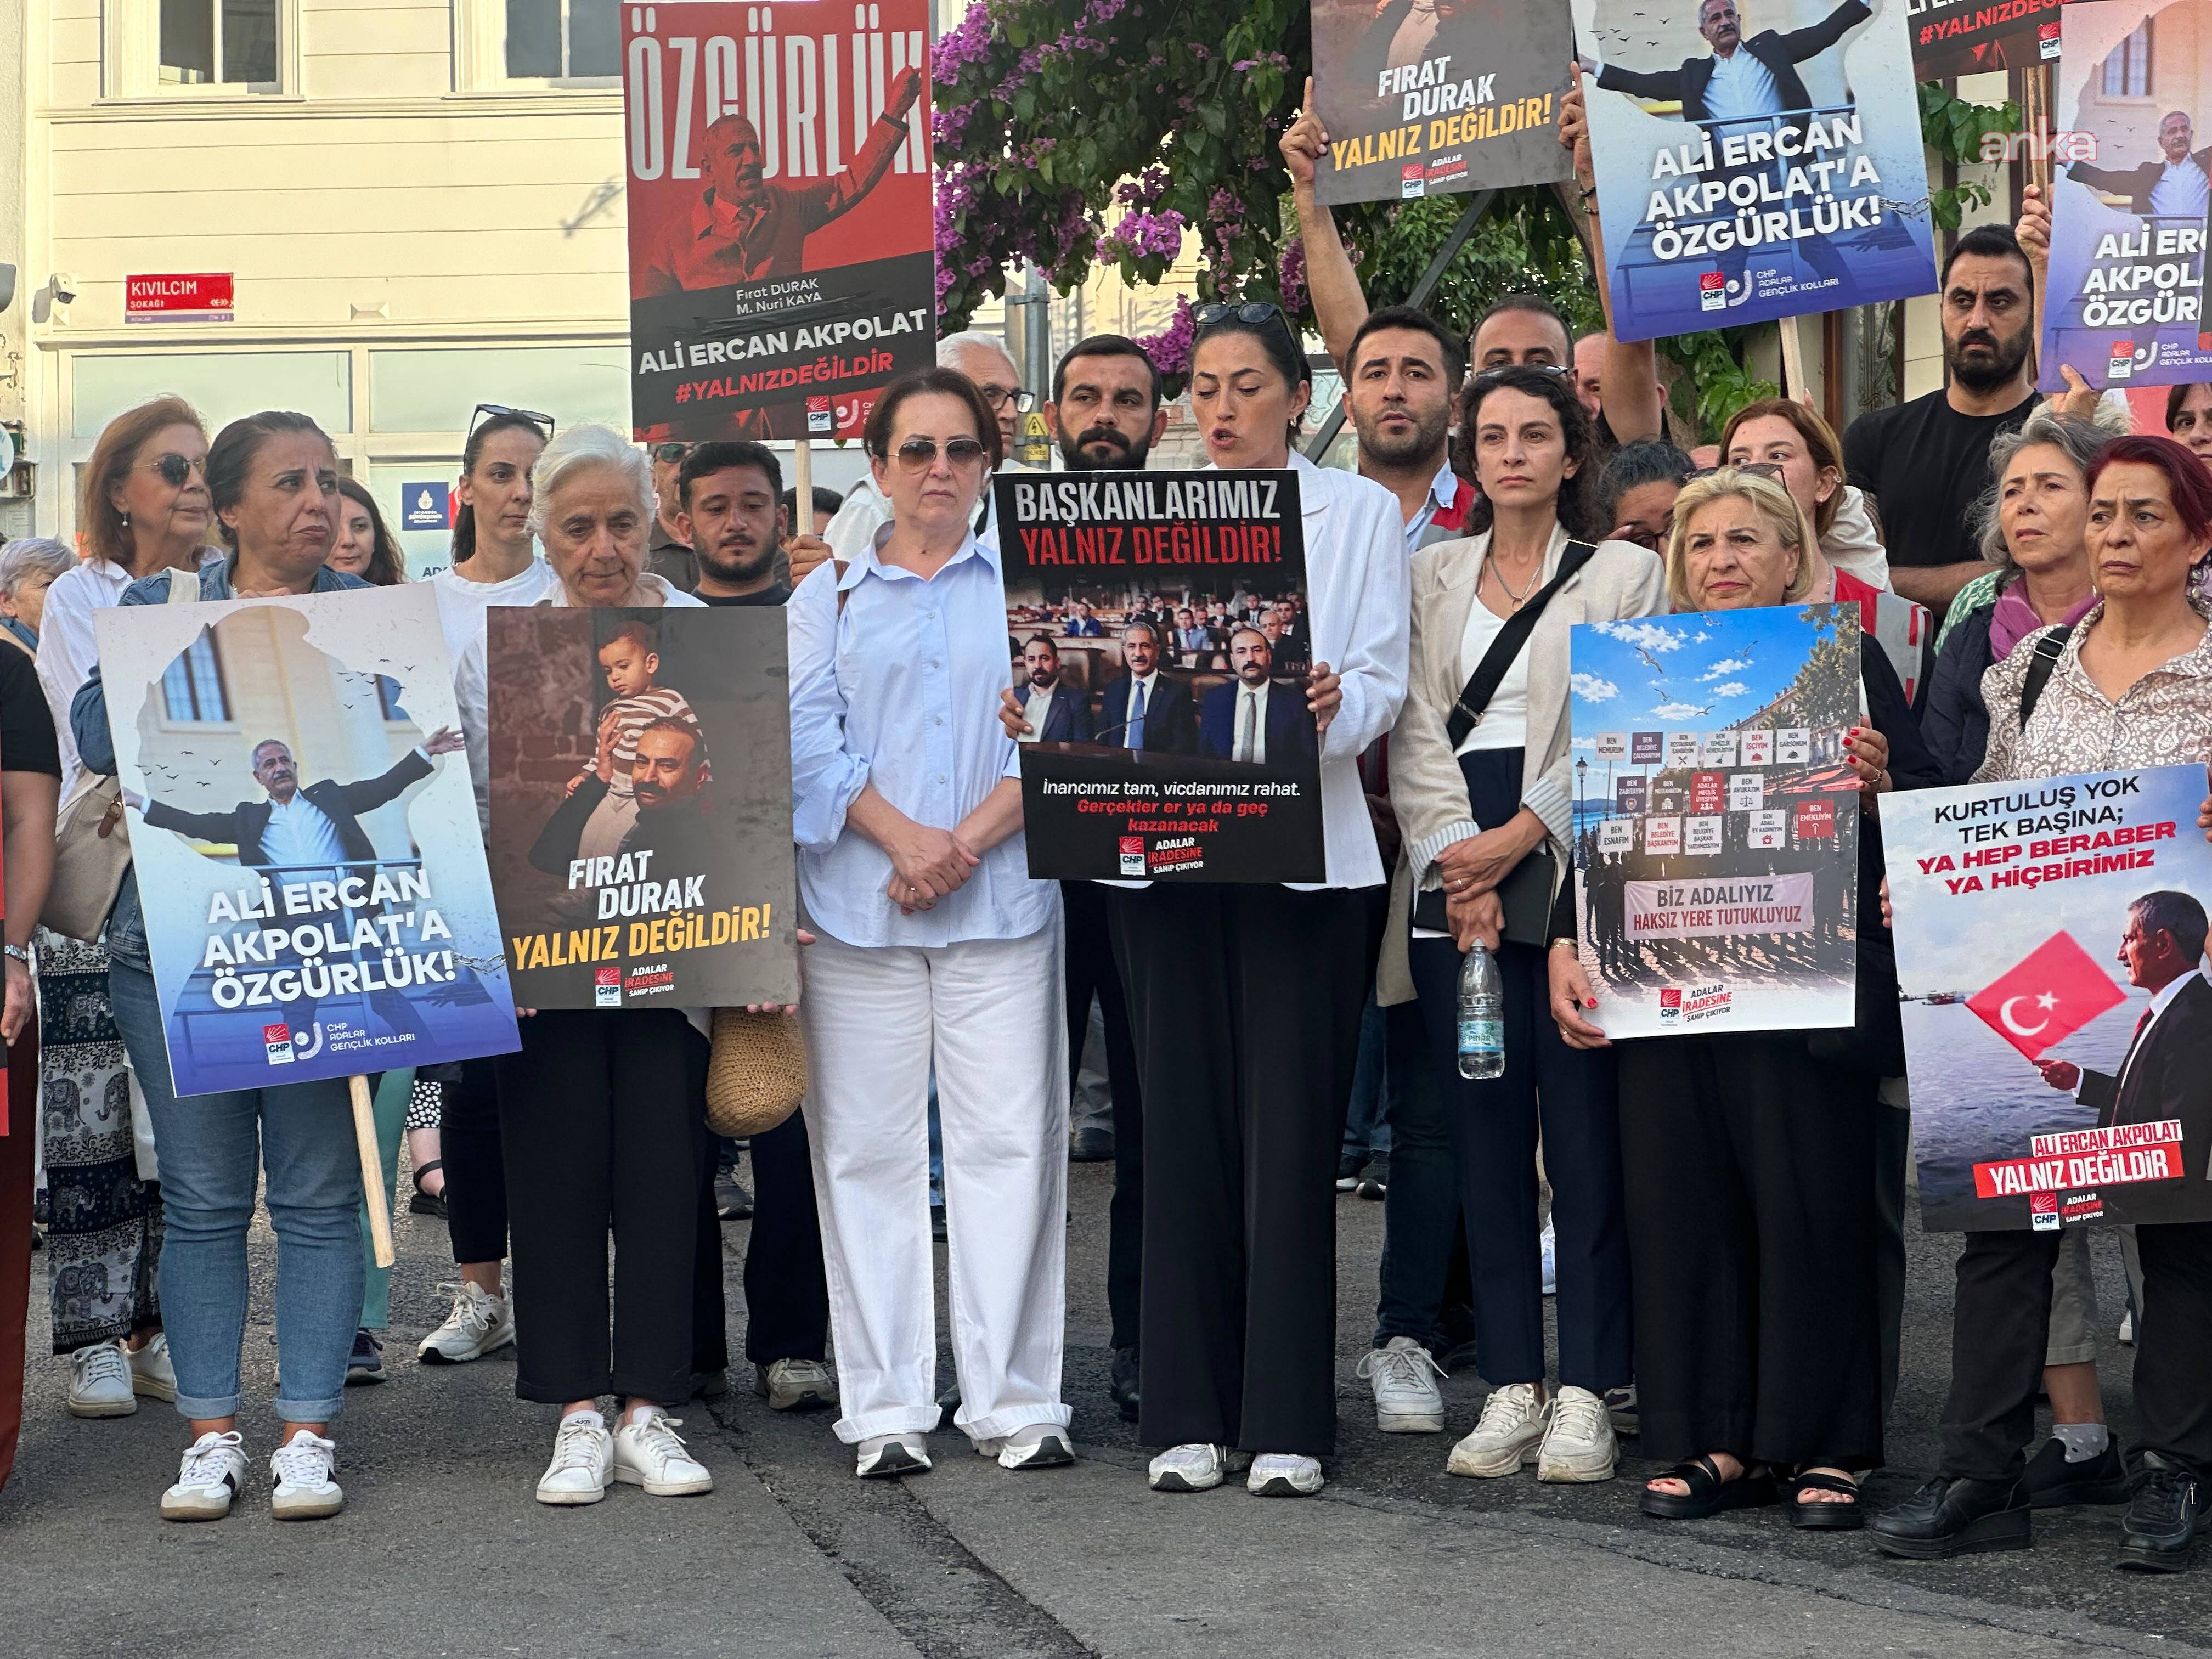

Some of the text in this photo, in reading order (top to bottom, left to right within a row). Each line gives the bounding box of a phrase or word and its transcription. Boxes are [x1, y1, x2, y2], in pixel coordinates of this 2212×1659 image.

[1378, 55, 1452, 97] FIRAT
[628, 5, 927, 180] ÖZGÜRLÜK
[1402, 72, 1497, 121] DURAK
[1331, 92, 1553, 171] YALNIZ DEĞİLDİR!
[1652, 115, 1863, 180] ALİ ERCAN
[1431, 154, 1463, 167] ADALAR
[1404, 180, 1422, 189] CHP
[1645, 155, 1881, 222] AKPOLAT'A
[1651, 193, 1882, 261] ÖZGÜRLÜK!
[2094, 223, 2208, 259] ALİ ER
[1756, 269, 1777, 279] CHP
[1758, 276, 1793, 287] ADALAR
[2082, 262, 2204, 294] AKPOL
[131, 280, 198, 296] KIVILCIM
[736, 278, 819, 301] Fırat DURAK
[1703, 291, 1723, 300] CHP
[1758, 278, 1839, 297] GENÇLİK KOLLARI
[130, 299, 164, 308] SOKAĞI
[736, 292, 822, 315] M. Nuri KAYA
[2083, 290, 2203, 327] ÖZGÜR
[639, 308, 927, 374] ALİ ERCAN AKPOLAT
[675, 348, 894, 404] #YALNIZDEĞİLDİR
[810, 413, 828, 421] CHP
[1014, 480, 1280, 527] BAŞKANLARIMIZ
[1020, 521, 1282, 566] YALNIZ DEĞİLDİR!
[1043, 778, 1301, 797] İnancımız tam, vicdanımız rahat.
[1077, 799, 1268, 817] Gerçekler er ya da geç
[1935, 776, 2140, 824] KURTULUŞ YOK
[1128, 818, 1220, 832] kazanacak
[1800, 814, 1831, 822] EMEKLİYİM
[1958, 805, 2124, 844] TEK BAŞINA;
[1155, 837, 1195, 850] ADALAR
[1604, 836, 1629, 845] ESNAFIM
[1917, 821, 2177, 875] YA HEP BERABER
[1122, 855, 1142, 864] CHP
[1147, 847, 1203, 864] İRADESİNE
[568, 849, 653, 890] FIRAT
[1153, 864, 1174, 874] SAHİP
[1175, 861, 1204, 872] ÇIKIYOR
[1945, 848, 2155, 896] YA HİÇBİRİMİZ
[208, 868, 431, 923] ALİ ERCAN
[597, 874, 706, 921] DURAK
[1657, 884, 1774, 907] BİZ ADALIYIZ
[1634, 906, 1801, 931] HAKSIZ YERE TUTUKLUYUZ
[204, 909, 452, 968] AKPOLAT'A
[512, 903, 771, 970] YALNIZ DEĞİLDİR!
[211, 947, 456, 1009] ÖZGÜRLÜK!
[625, 972, 674, 988] İRADESİNE
[632, 963, 667, 977] ADALAR
[598, 986, 619, 995] CHP
[629, 984, 674, 997] SAHİP ÇIKIYOR
[1690, 984, 1724, 998] ADALAR
[1682, 991, 1732, 1013] İRADESİNE
[1661, 1009, 1679, 1017] CHP
[1686, 1006, 1731, 1022] SAHİP ÇIKIYOR
[326, 1022, 348, 1032] CHP
[330, 1029, 366, 1041] ADALAR
[268, 1043, 290, 1053] CHP
[330, 1033, 415, 1051] GENÇLİK KOLLARI
[2035, 1121, 2180, 1156] ALİ ERCAN AKPOLAT
[1988, 1149, 2169, 1195] YALNIZ DEĞİLDİR
[2067, 1193, 2097, 1205] ADALAR
[2034, 1214, 2056, 1224] CHP
